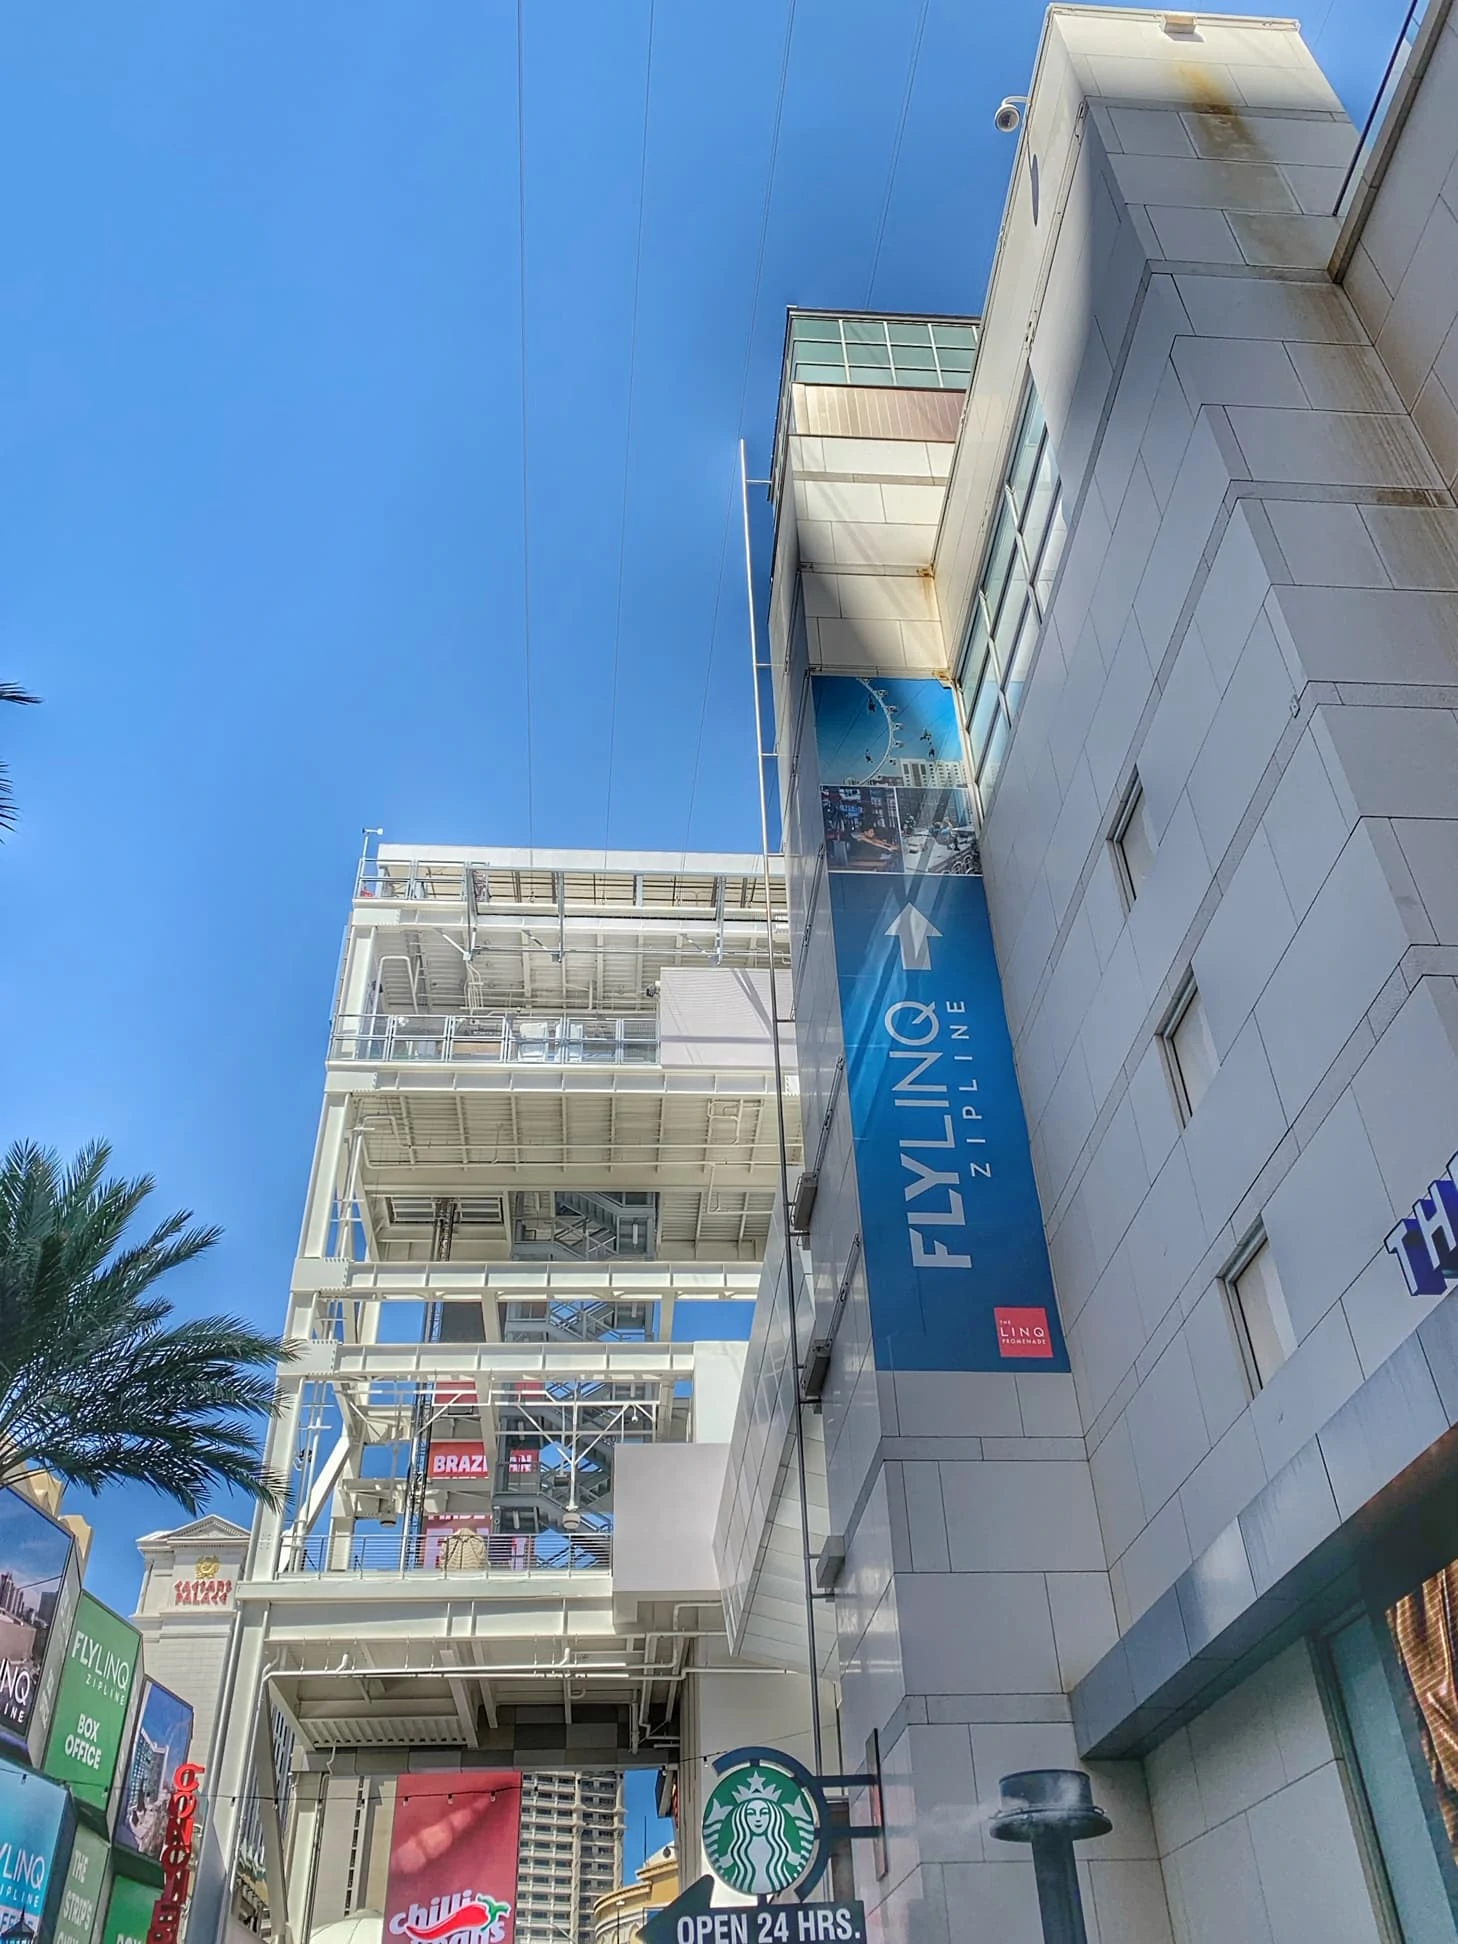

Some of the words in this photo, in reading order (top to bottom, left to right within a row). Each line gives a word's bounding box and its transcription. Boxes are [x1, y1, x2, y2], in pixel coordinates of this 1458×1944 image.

[946, 1000, 992, 1178] ZIPLINE
[885, 1000, 972, 1269] FLYLINQ
[1384, 1151, 1458, 1296] TH
[1000, 1327, 1044, 1337] LINQ
[71, 1630, 130, 1690] FLYLINQ
[85, 1673, 126, 1706] ZIPLINE
[77, 1713, 101, 1743] BOX
[64, 1734, 102, 1771] OFFICE
[677, 1912, 748, 1944] OPEN
[757, 1911, 789, 1944] 24
[797, 1908, 861, 1942] HRS.
